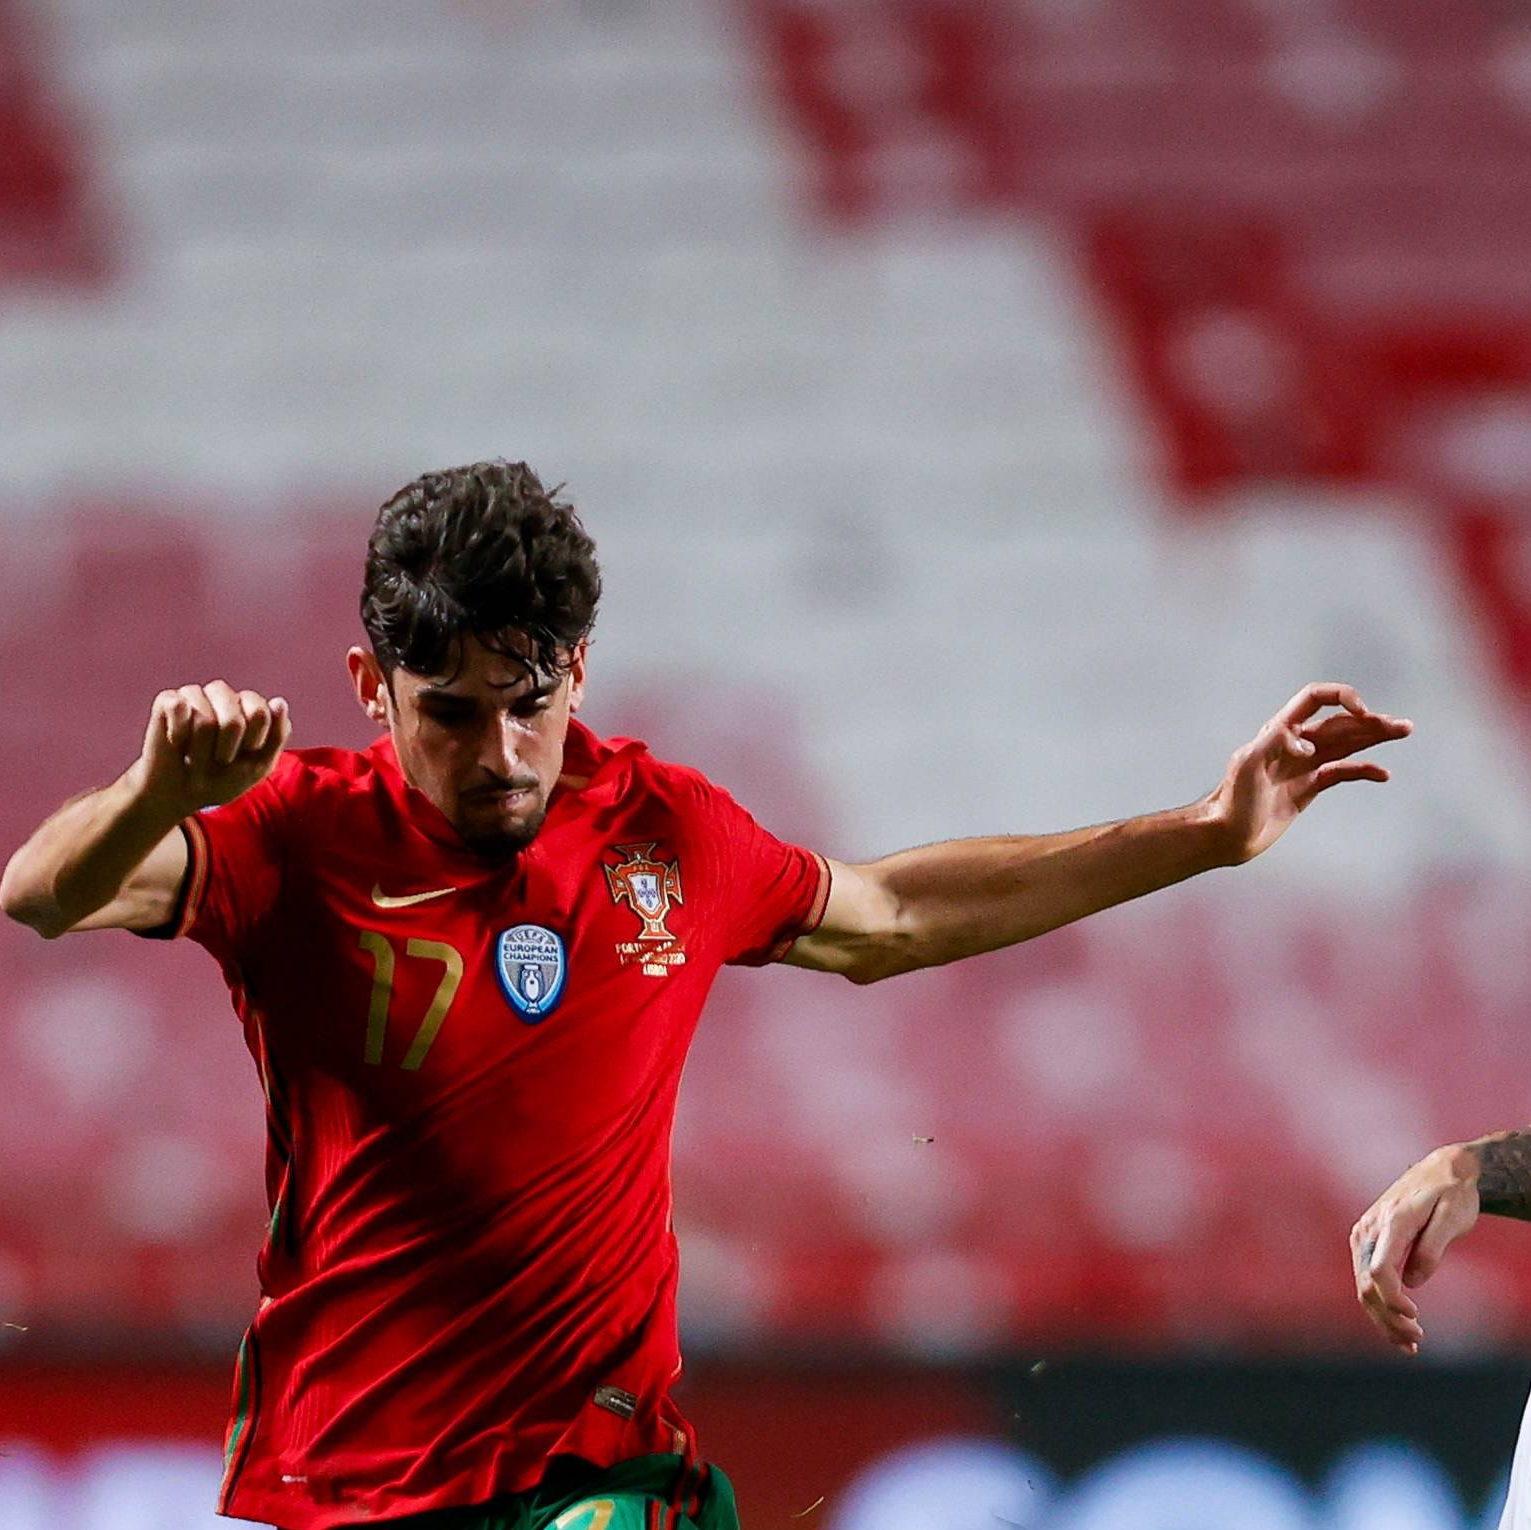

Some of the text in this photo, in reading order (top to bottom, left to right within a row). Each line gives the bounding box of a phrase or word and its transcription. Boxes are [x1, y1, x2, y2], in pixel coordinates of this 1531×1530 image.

[503, 943, 558, 954] EUROPEAN
[503, 952, 559, 963] CHAMPIONS
[357, 930, 464, 1071] 17
